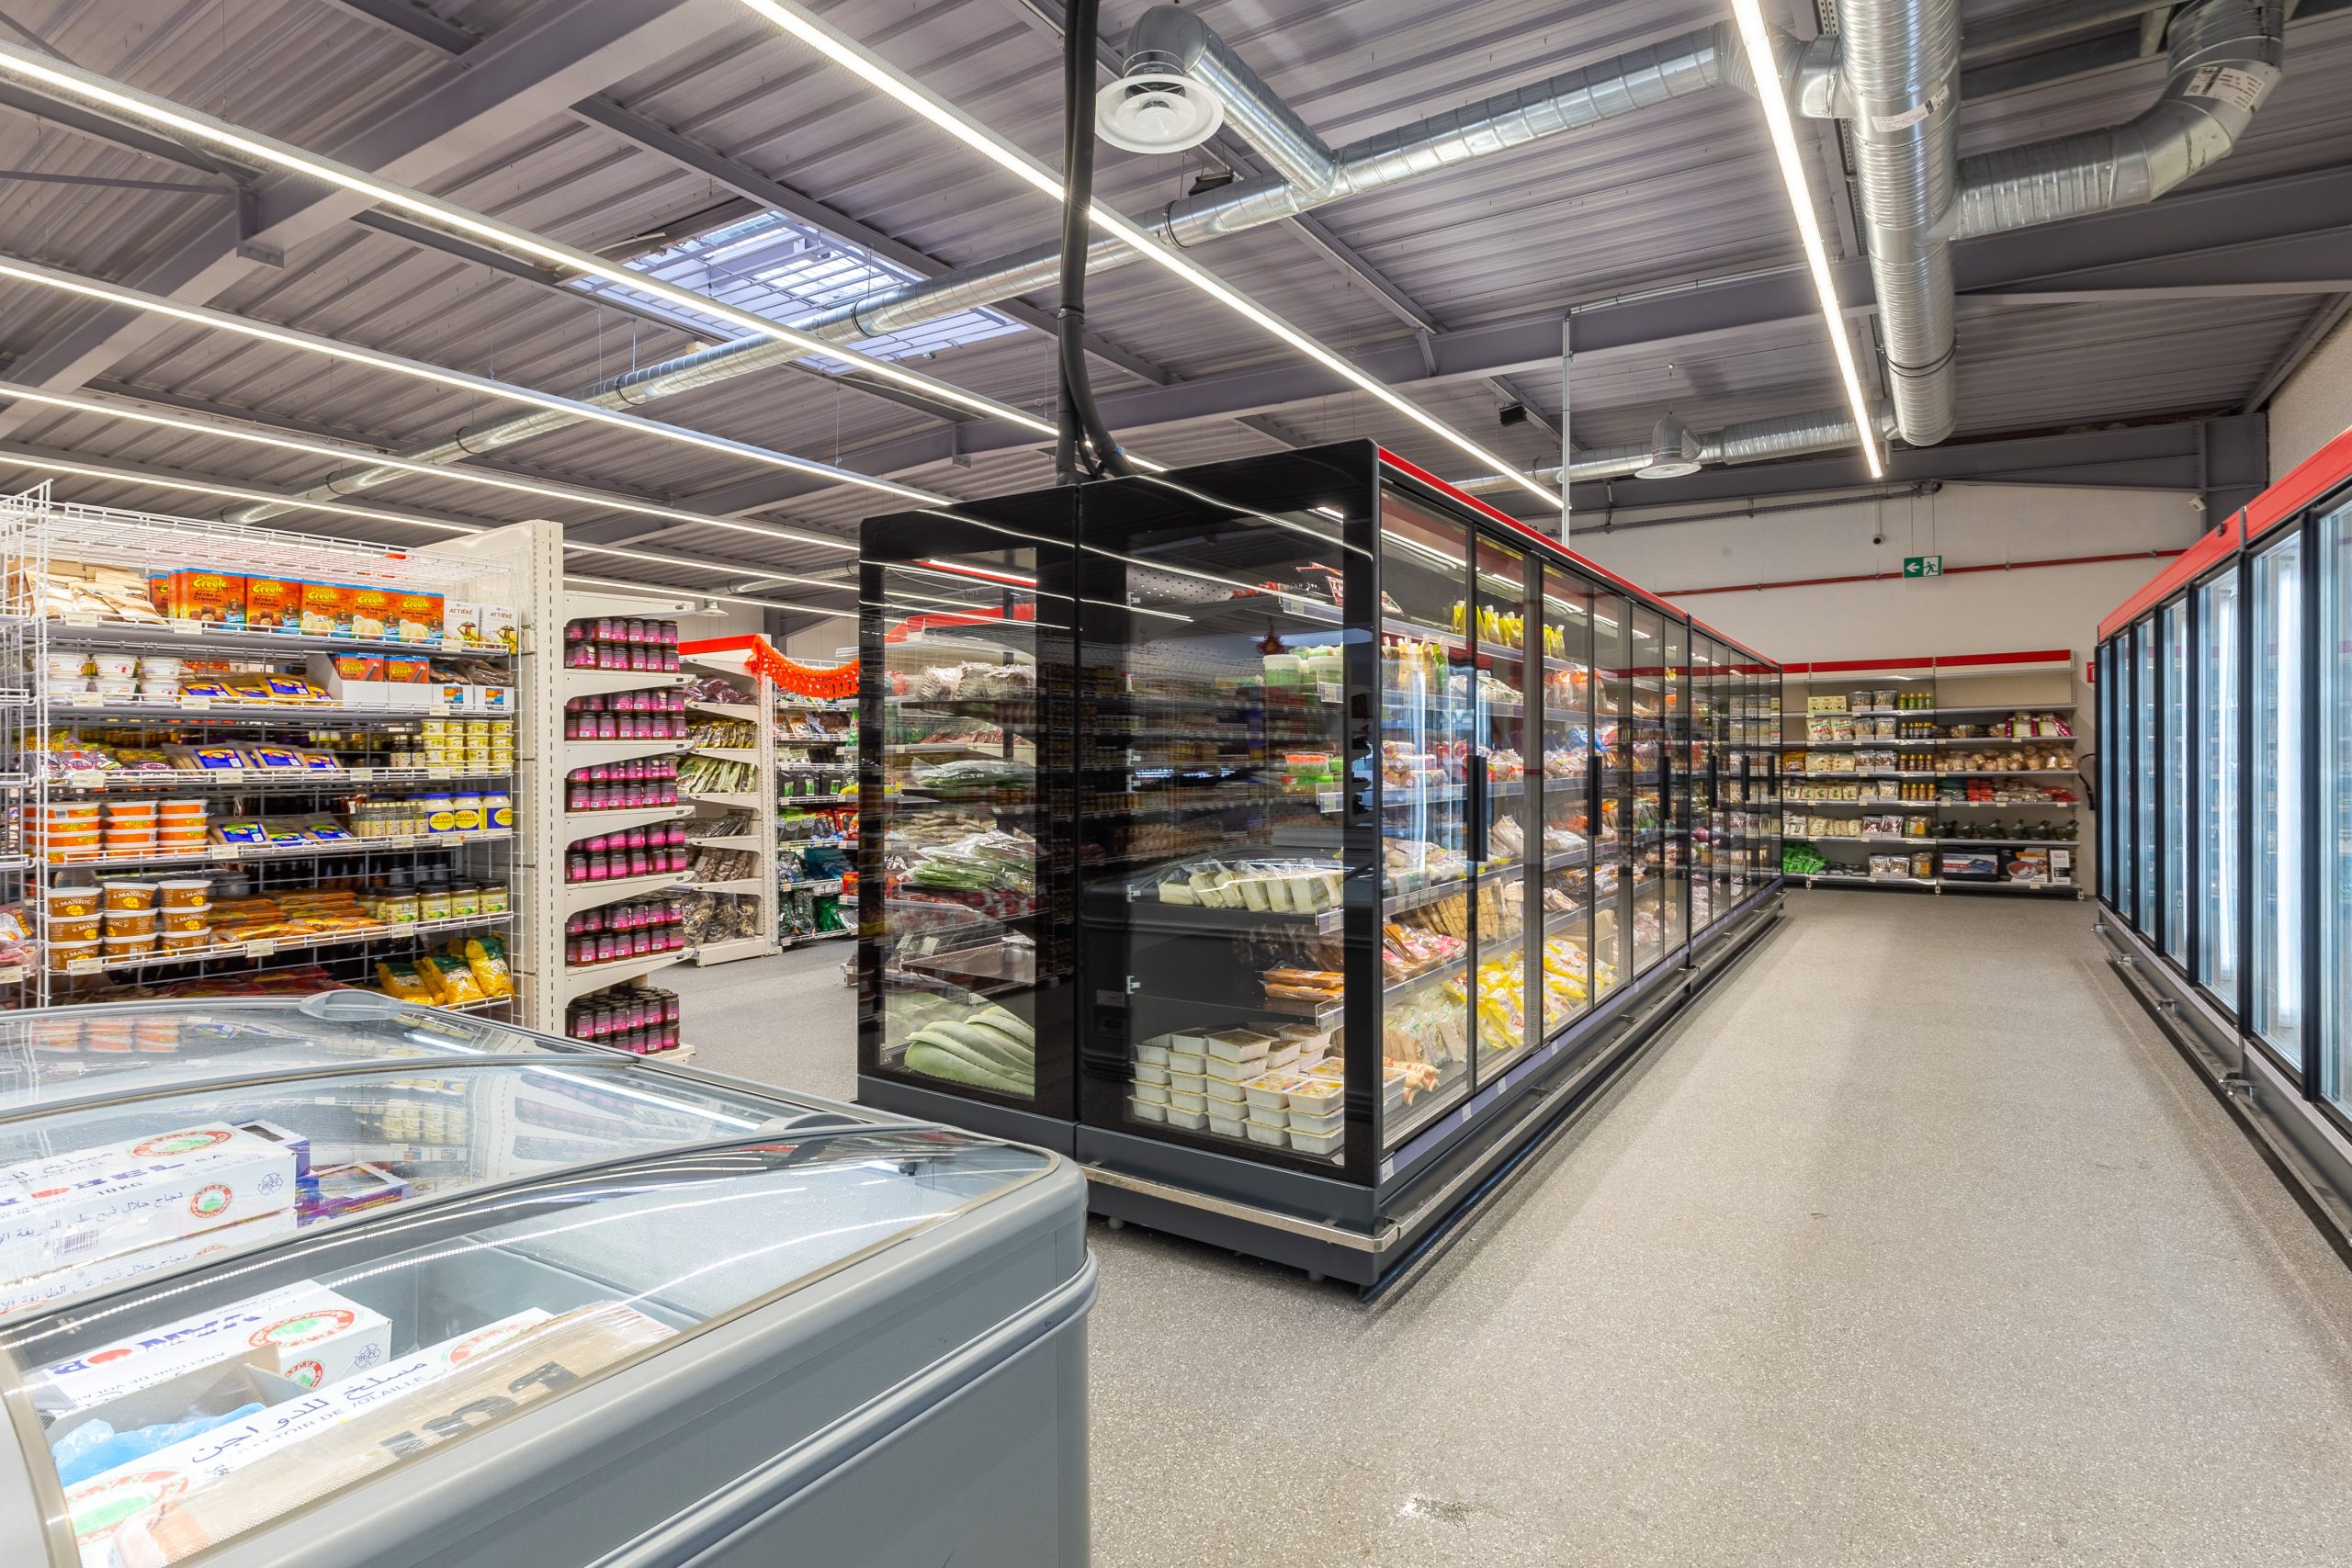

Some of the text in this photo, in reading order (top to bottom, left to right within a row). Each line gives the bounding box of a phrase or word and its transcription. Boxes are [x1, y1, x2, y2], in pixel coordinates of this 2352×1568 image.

[117, 891, 149, 899] MANIOC
[59, 898, 93, 907] MANIOC
[343, 1361, 428, 1401] مسلخ
